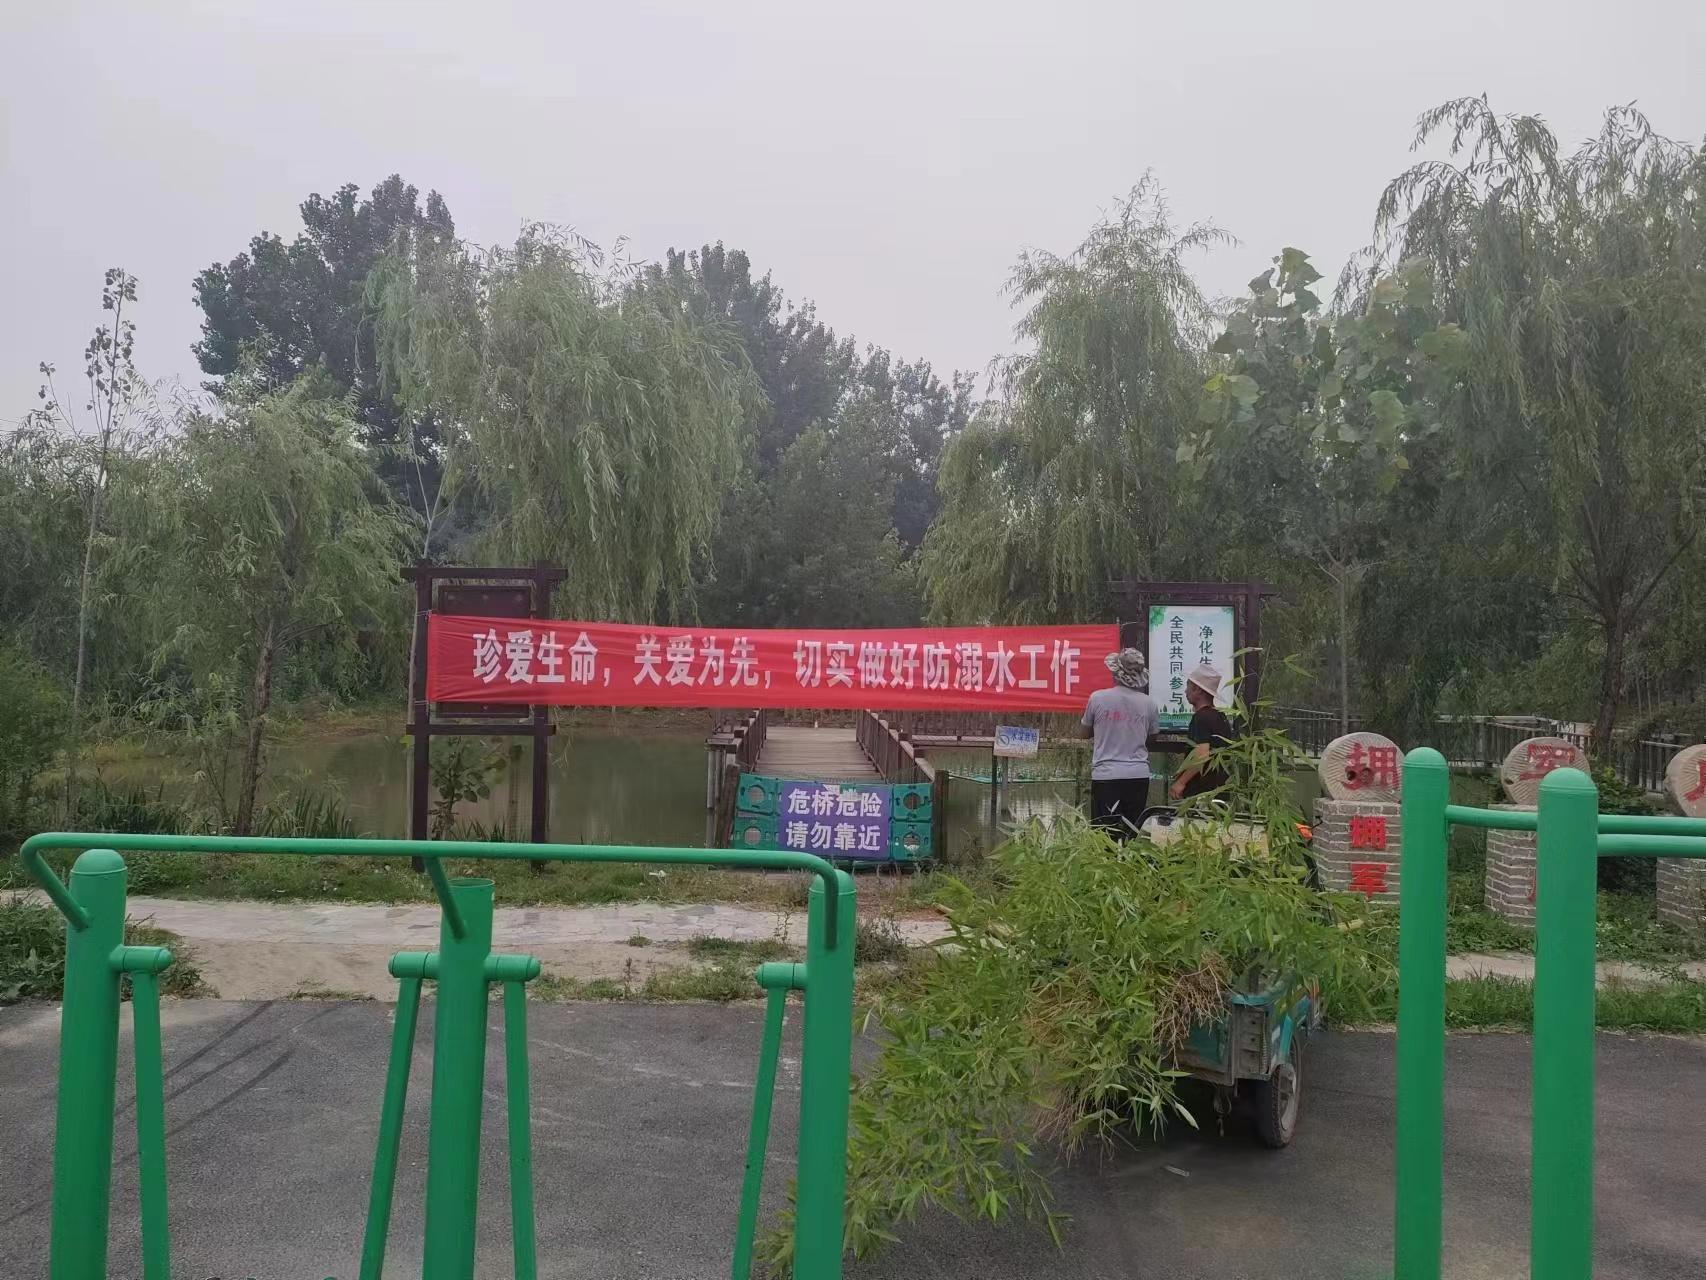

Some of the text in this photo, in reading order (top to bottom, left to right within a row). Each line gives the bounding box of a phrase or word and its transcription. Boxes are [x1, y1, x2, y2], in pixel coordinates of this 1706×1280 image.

[1169, 615, 1184, 706] 全民共同参与
[787, 787, 883, 818] 危桥危险
[785, 820, 881, 851] 请勿靠近
